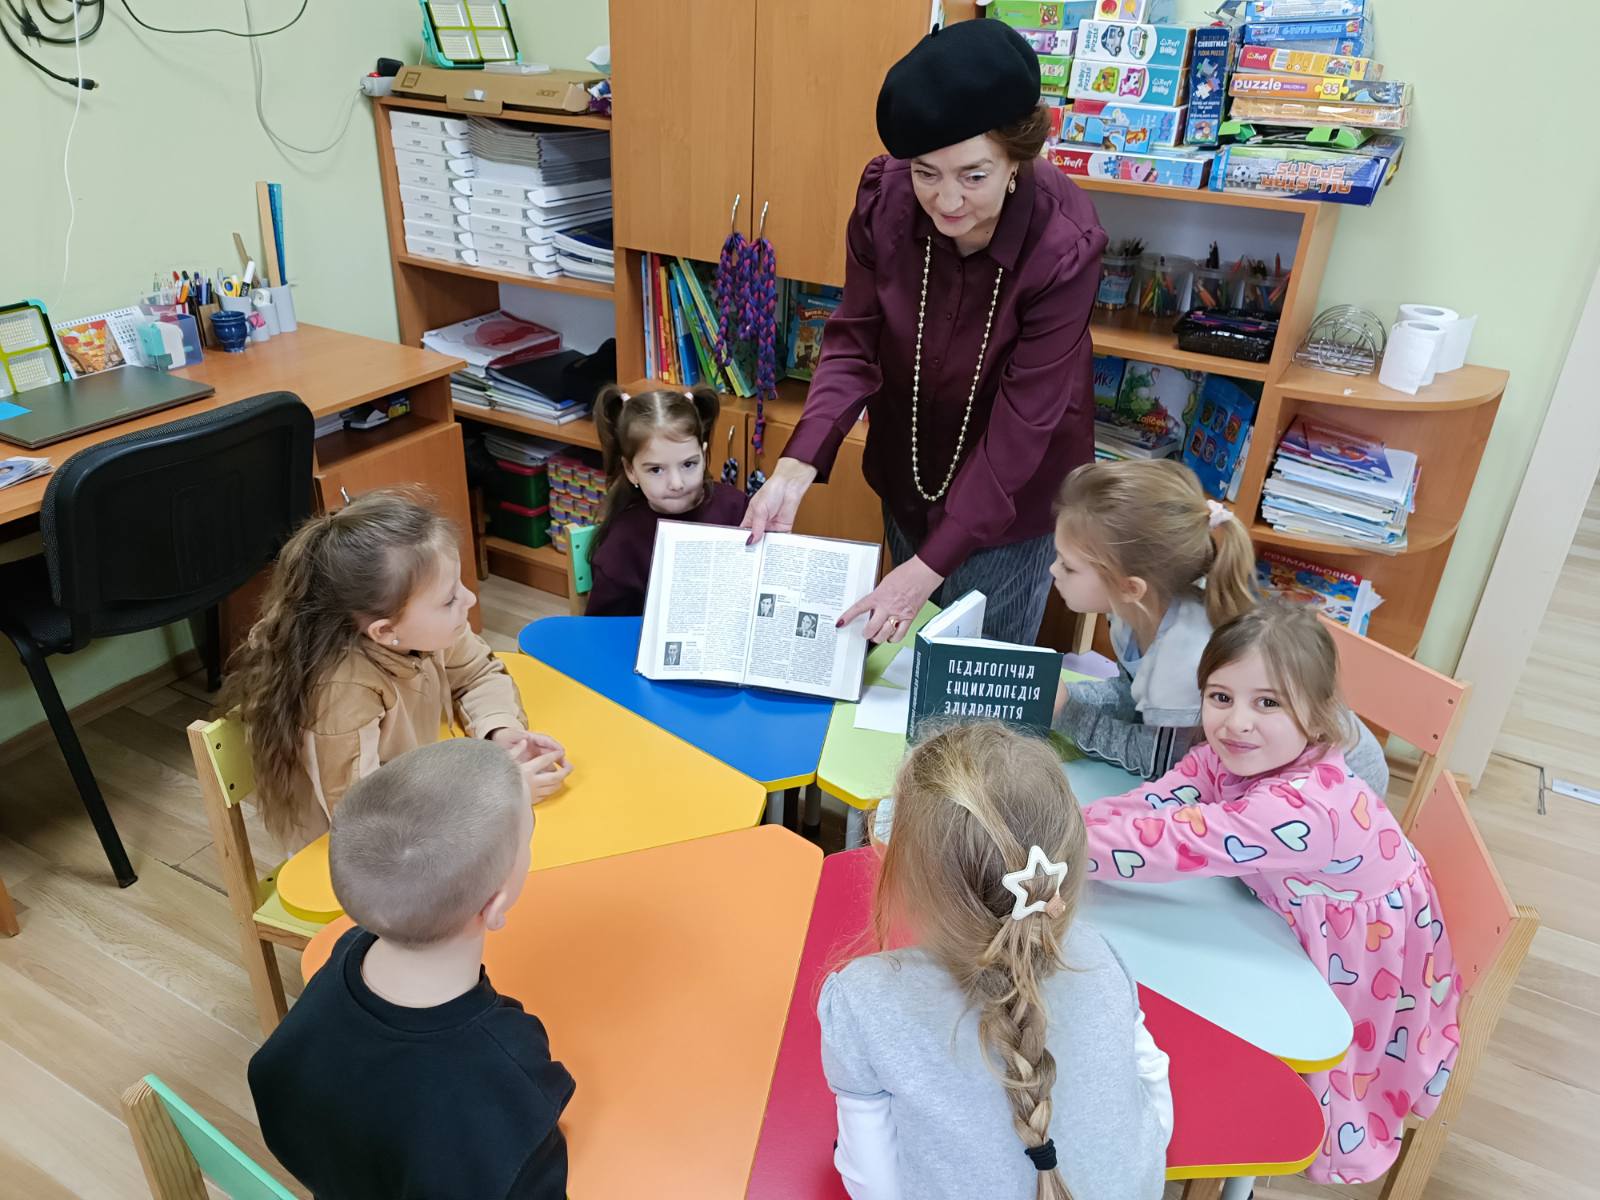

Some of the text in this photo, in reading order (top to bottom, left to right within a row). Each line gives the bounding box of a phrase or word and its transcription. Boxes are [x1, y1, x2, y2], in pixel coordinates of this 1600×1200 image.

[1234, 78, 1282, 91] puzzle
[1323, 83, 1339, 95] 35
[536, 89, 560, 98] acer
[1063, 156, 1083, 168] Trefl
[1276, 161, 1345, 180] SPORTS
[1264, 551, 1357, 583] РОЗМАЛЬОВКА
[948, 659, 1035, 680] ПЕДАГОГІЧНА
[943, 701, 1024, 720] ЗАКАРПАТТЯ
